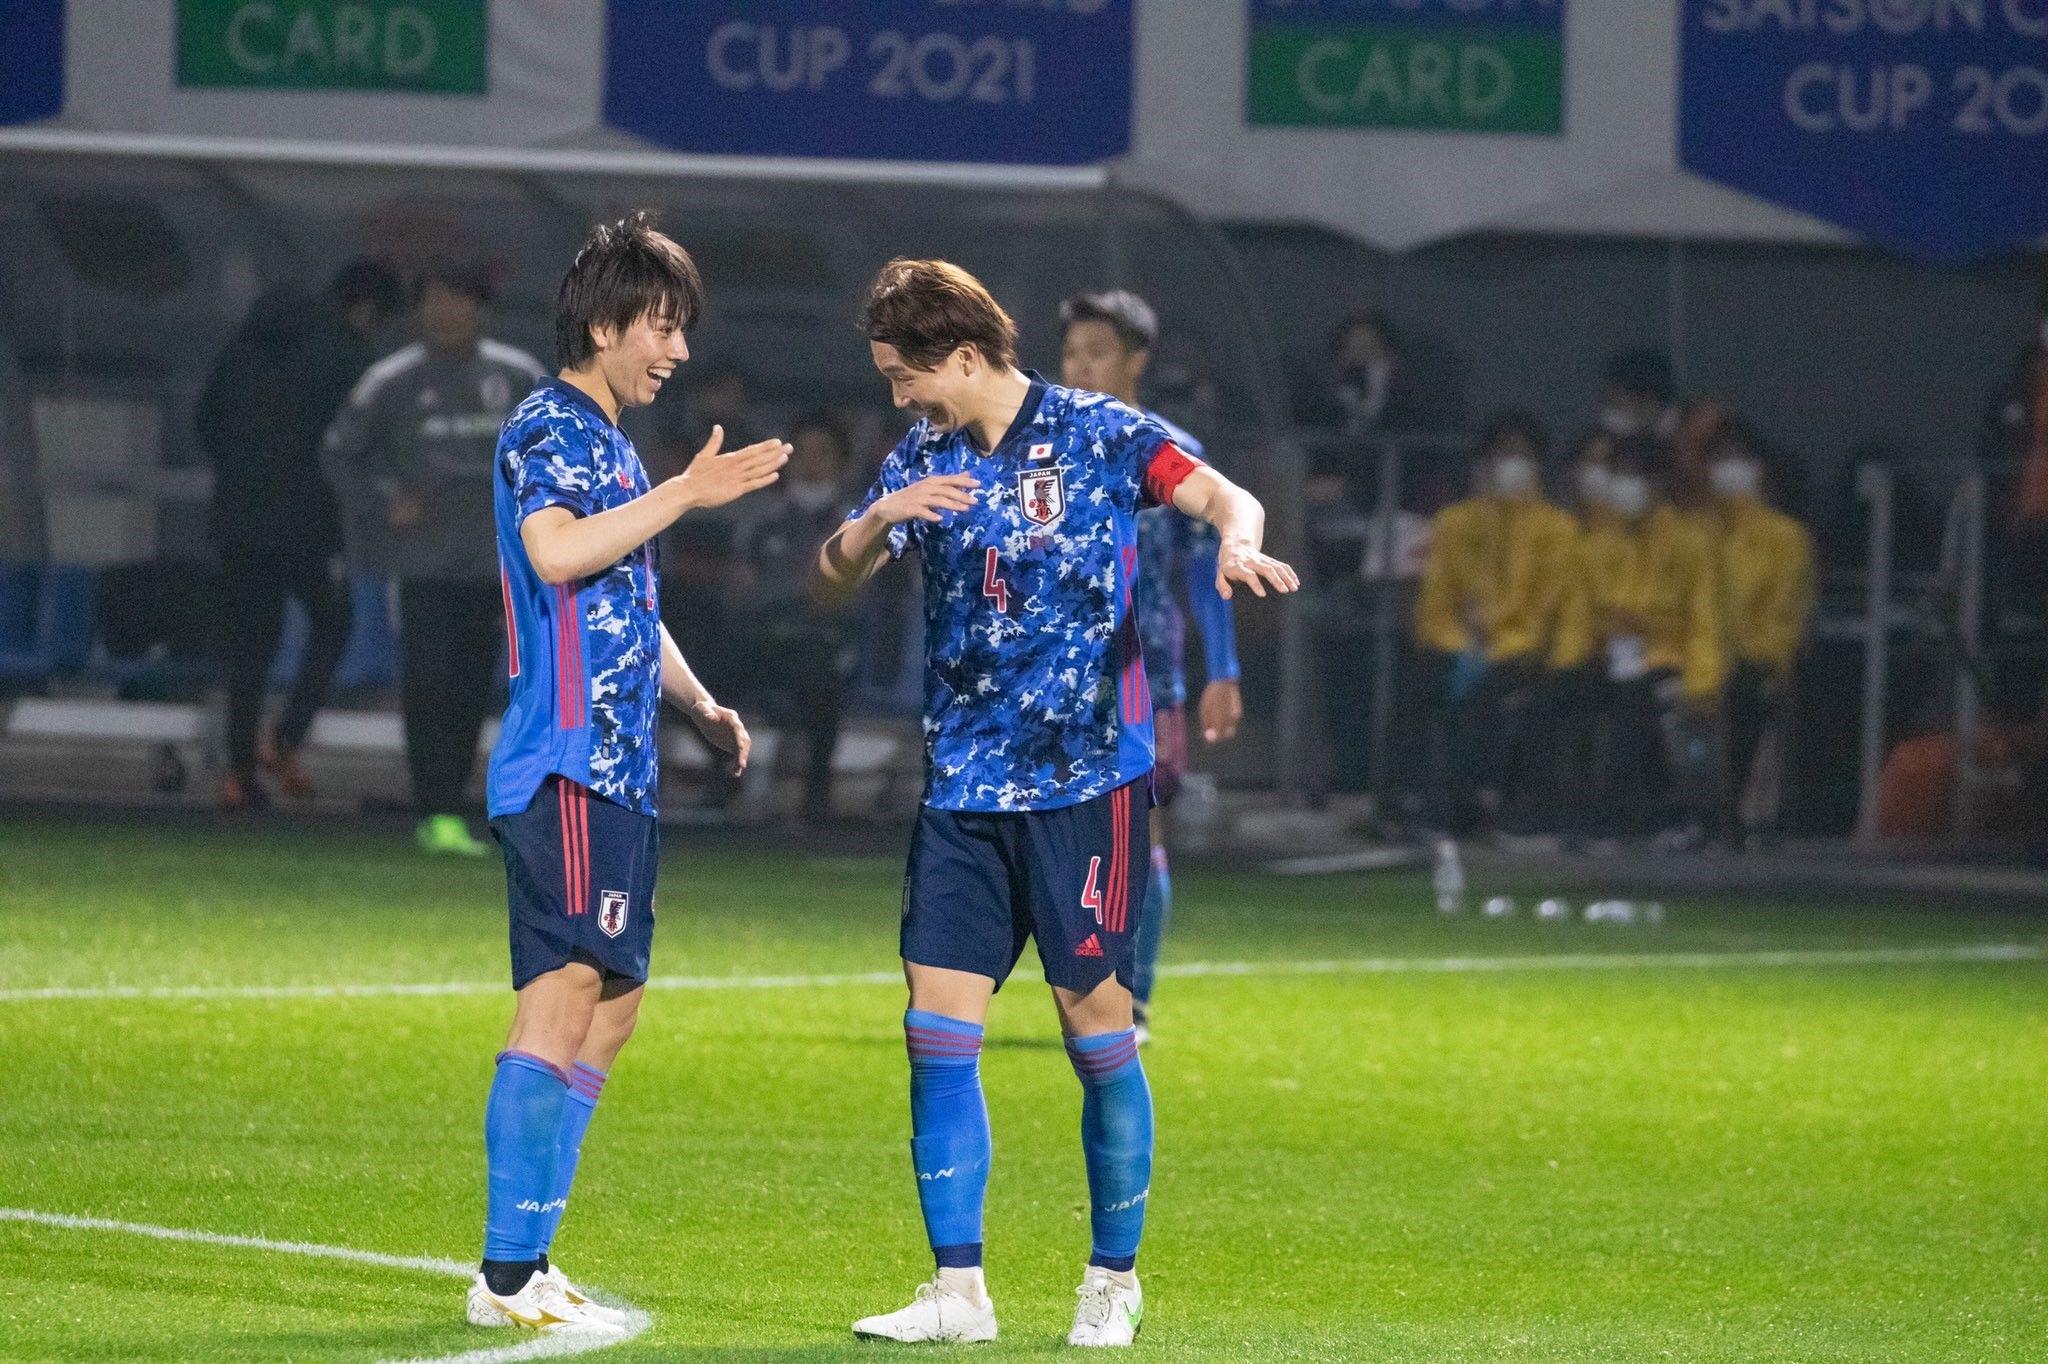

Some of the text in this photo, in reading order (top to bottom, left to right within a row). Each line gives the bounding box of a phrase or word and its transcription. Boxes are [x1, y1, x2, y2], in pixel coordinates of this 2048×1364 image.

[225, 3, 438, 76] CARD
[706, 20, 1036, 104] CUP 2021
[1297, 38, 1515, 117] CARD
[1783, 61, 1933, 131] CUP
[1029, 470, 1051, 478] JAPAN
[983, 546, 1007, 613] 4
[1081, 856, 1102, 924] 4
[1074, 948, 1104, 957] adidas
[917, 1167, 954, 1180] AN
[1104, 1184, 1149, 1212] JAPA
